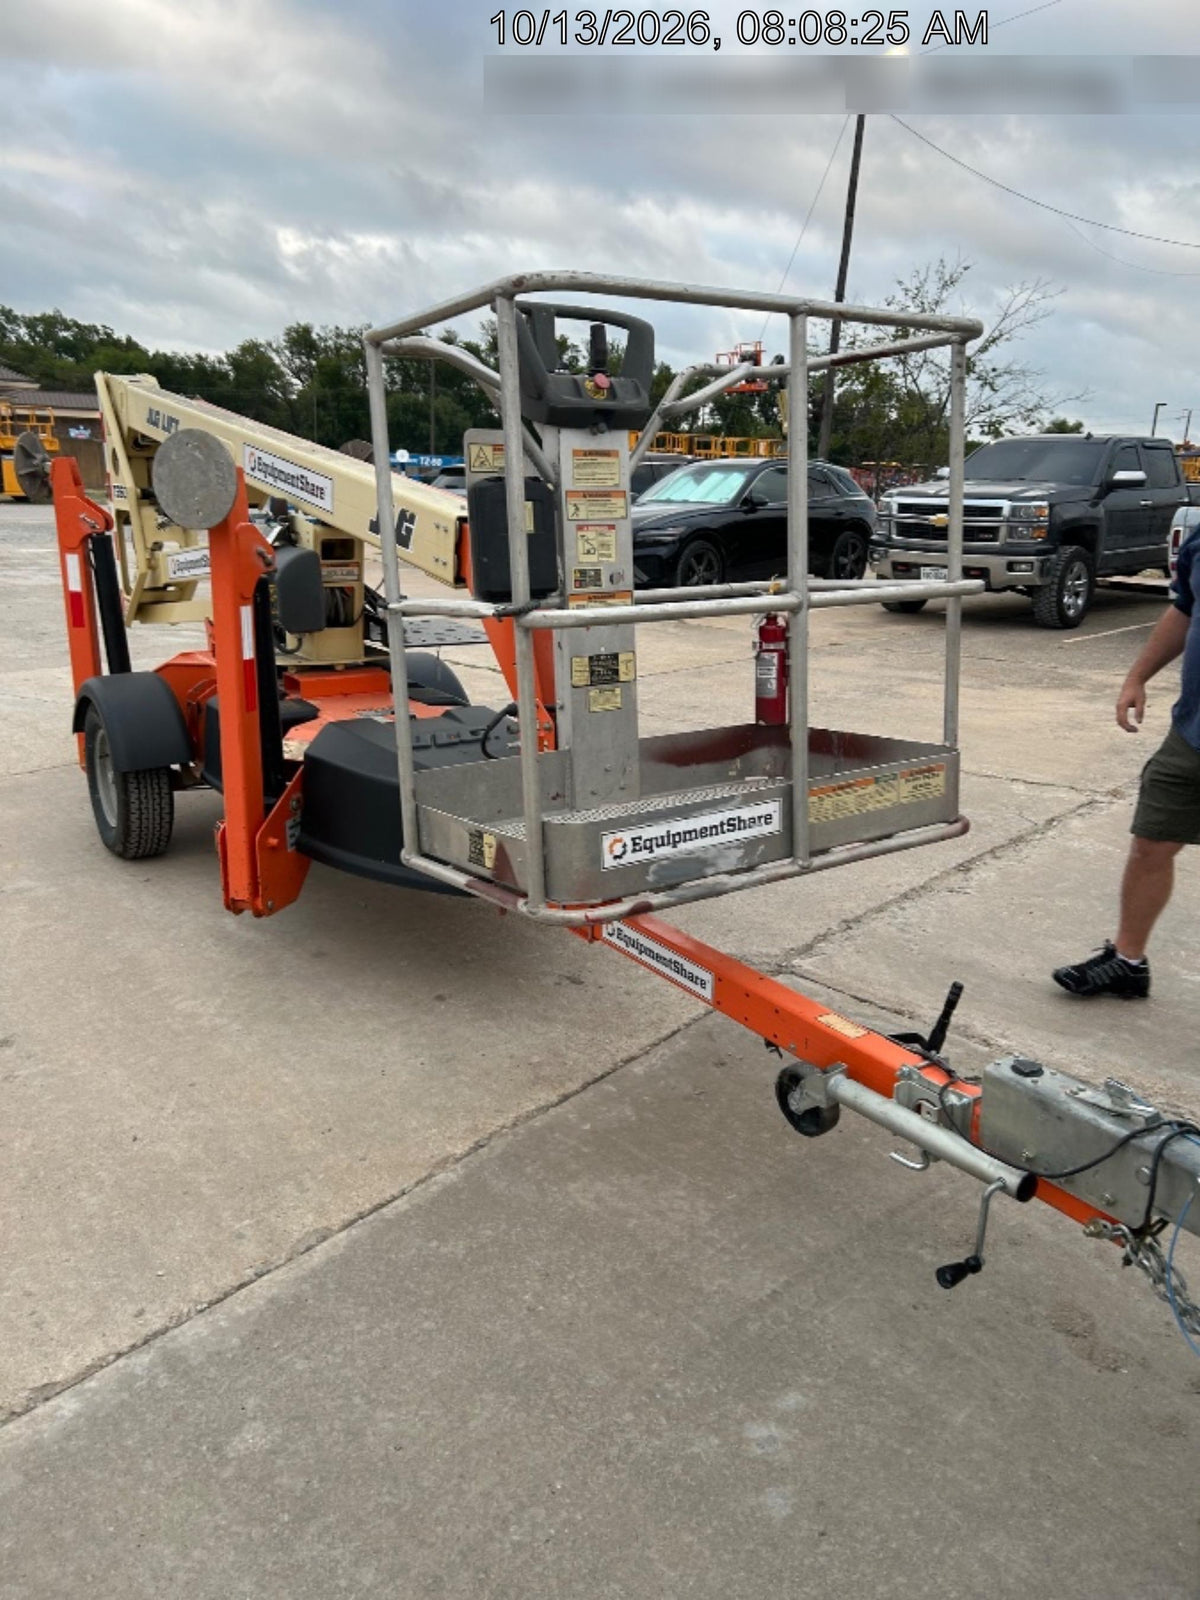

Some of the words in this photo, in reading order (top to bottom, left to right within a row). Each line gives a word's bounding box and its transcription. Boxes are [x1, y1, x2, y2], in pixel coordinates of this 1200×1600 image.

[257, 456, 326, 500] EquipmentShare
[631, 812, 773, 853] EquipmentShare
[616, 926, 707, 991] EquipmentShare
